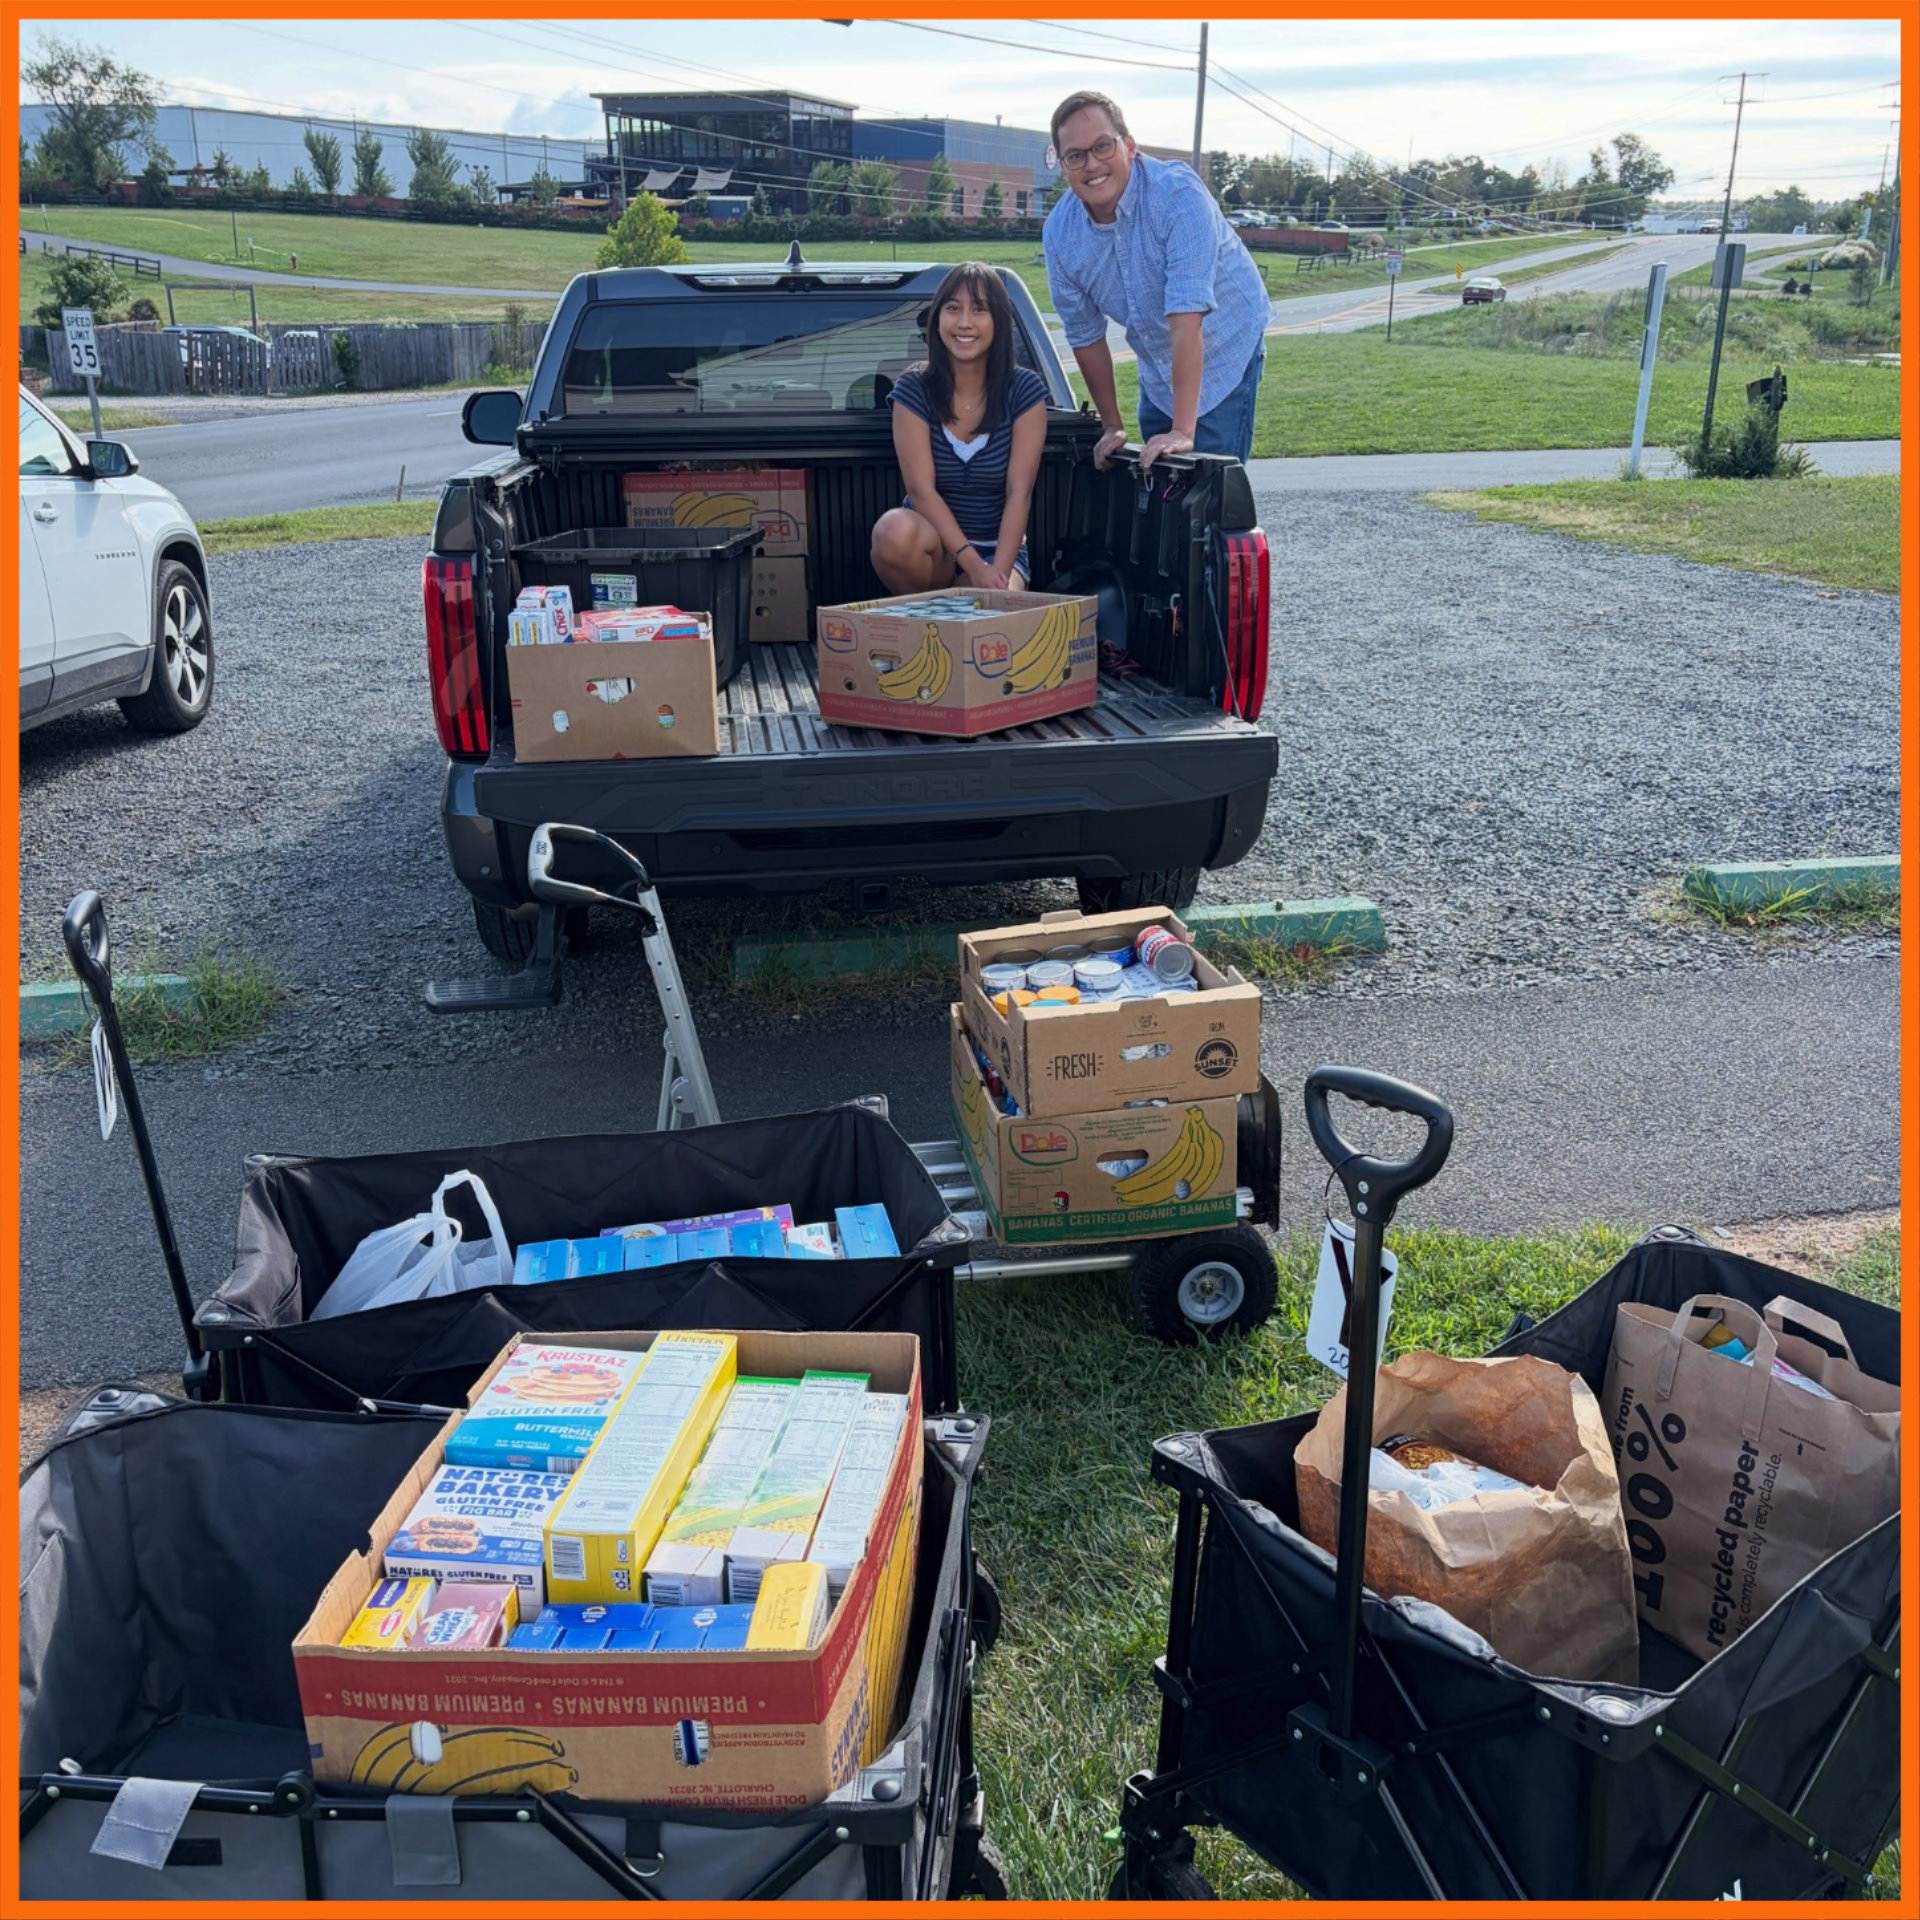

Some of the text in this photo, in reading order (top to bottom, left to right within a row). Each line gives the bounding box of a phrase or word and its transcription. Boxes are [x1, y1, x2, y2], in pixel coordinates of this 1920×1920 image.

[65, 315, 91, 328] SPEED
[70, 330, 90, 341] LIMIT
[71, 344, 97, 369] 35
[632, 506, 675, 517] BANANAS
[556, 607, 571, 637] Chex
[826, 621, 853, 640] Dole
[980, 640, 1008, 662] Dole
[1209, 1021, 1226, 1032] FROM
[1054, 1053, 1096, 1080] FRESH
[1194, 1056, 1239, 1072] SUNSET
[1021, 1131, 1068, 1150] Dole
[1008, 1199, 1233, 1230] BANANAS CERTIFIED ORGANIC BANANAS
[666, 1333, 725, 1346] Cheerios
[536, 1350, 628, 1368] KRUSTEAZ
[487, 1405, 603, 1417] GLUTEN FREE
[1615, 1386, 1634, 1431] from
[434, 1481, 565, 1502] BAKERY
[435, 1497, 547, 1513] GLUTEN FREE
[462, 1506, 513, 1518] FIG BAR
[1626, 1402, 1687, 1612] 100%
[1739, 1531, 1767, 1616] completely
[1754, 1452, 1783, 1531] recyclable.
[1706, 1440, 1760, 1647] recycled paper
[447, 1570, 483, 1579] GLUTEN
[425, 1610, 451, 1644] CREAM
[439, 1611, 466, 1643] WHEAT
[446, 1675, 468, 1683] 2021
[533, 1677, 556, 1686] Food
[557, 1677, 580, 1686] Dole
[341, 1689, 525, 1713] PREMIUM BANANAS
[553, 1695, 749, 1715] PREMIUM BANANAS
[753, 1731, 794, 1739] MAINTAIN
[668, 1783, 775, 1794] CHARLOTTE, NC 28231
[704, 1795, 737, 1807] FRUIT
[738, 1795, 774, 1806] FRESH
[775, 1794, 807, 1805] DOLE
